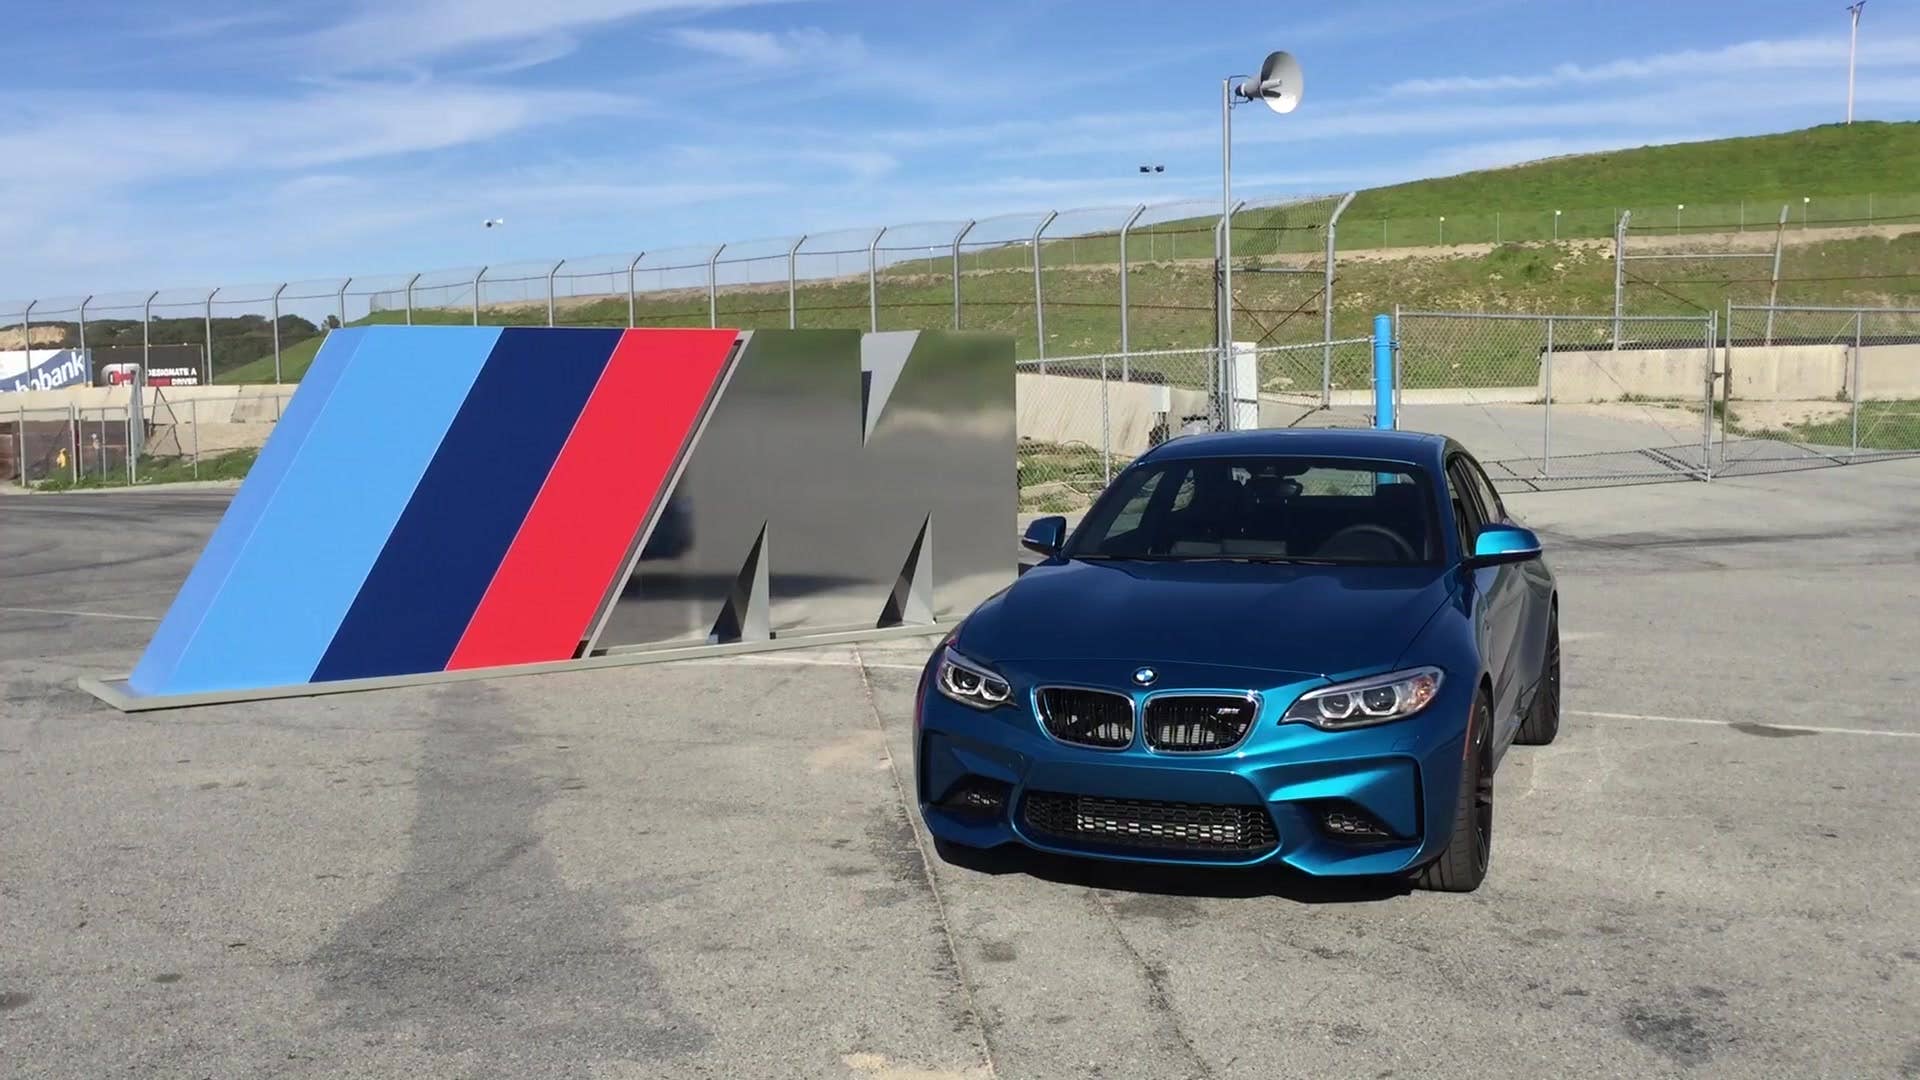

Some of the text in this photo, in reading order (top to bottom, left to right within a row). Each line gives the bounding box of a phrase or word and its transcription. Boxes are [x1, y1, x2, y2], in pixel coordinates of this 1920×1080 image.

[0, 351, 85, 392] bobank
[190, 367, 197, 376] A
[171, 377, 198, 385] DRIVER
